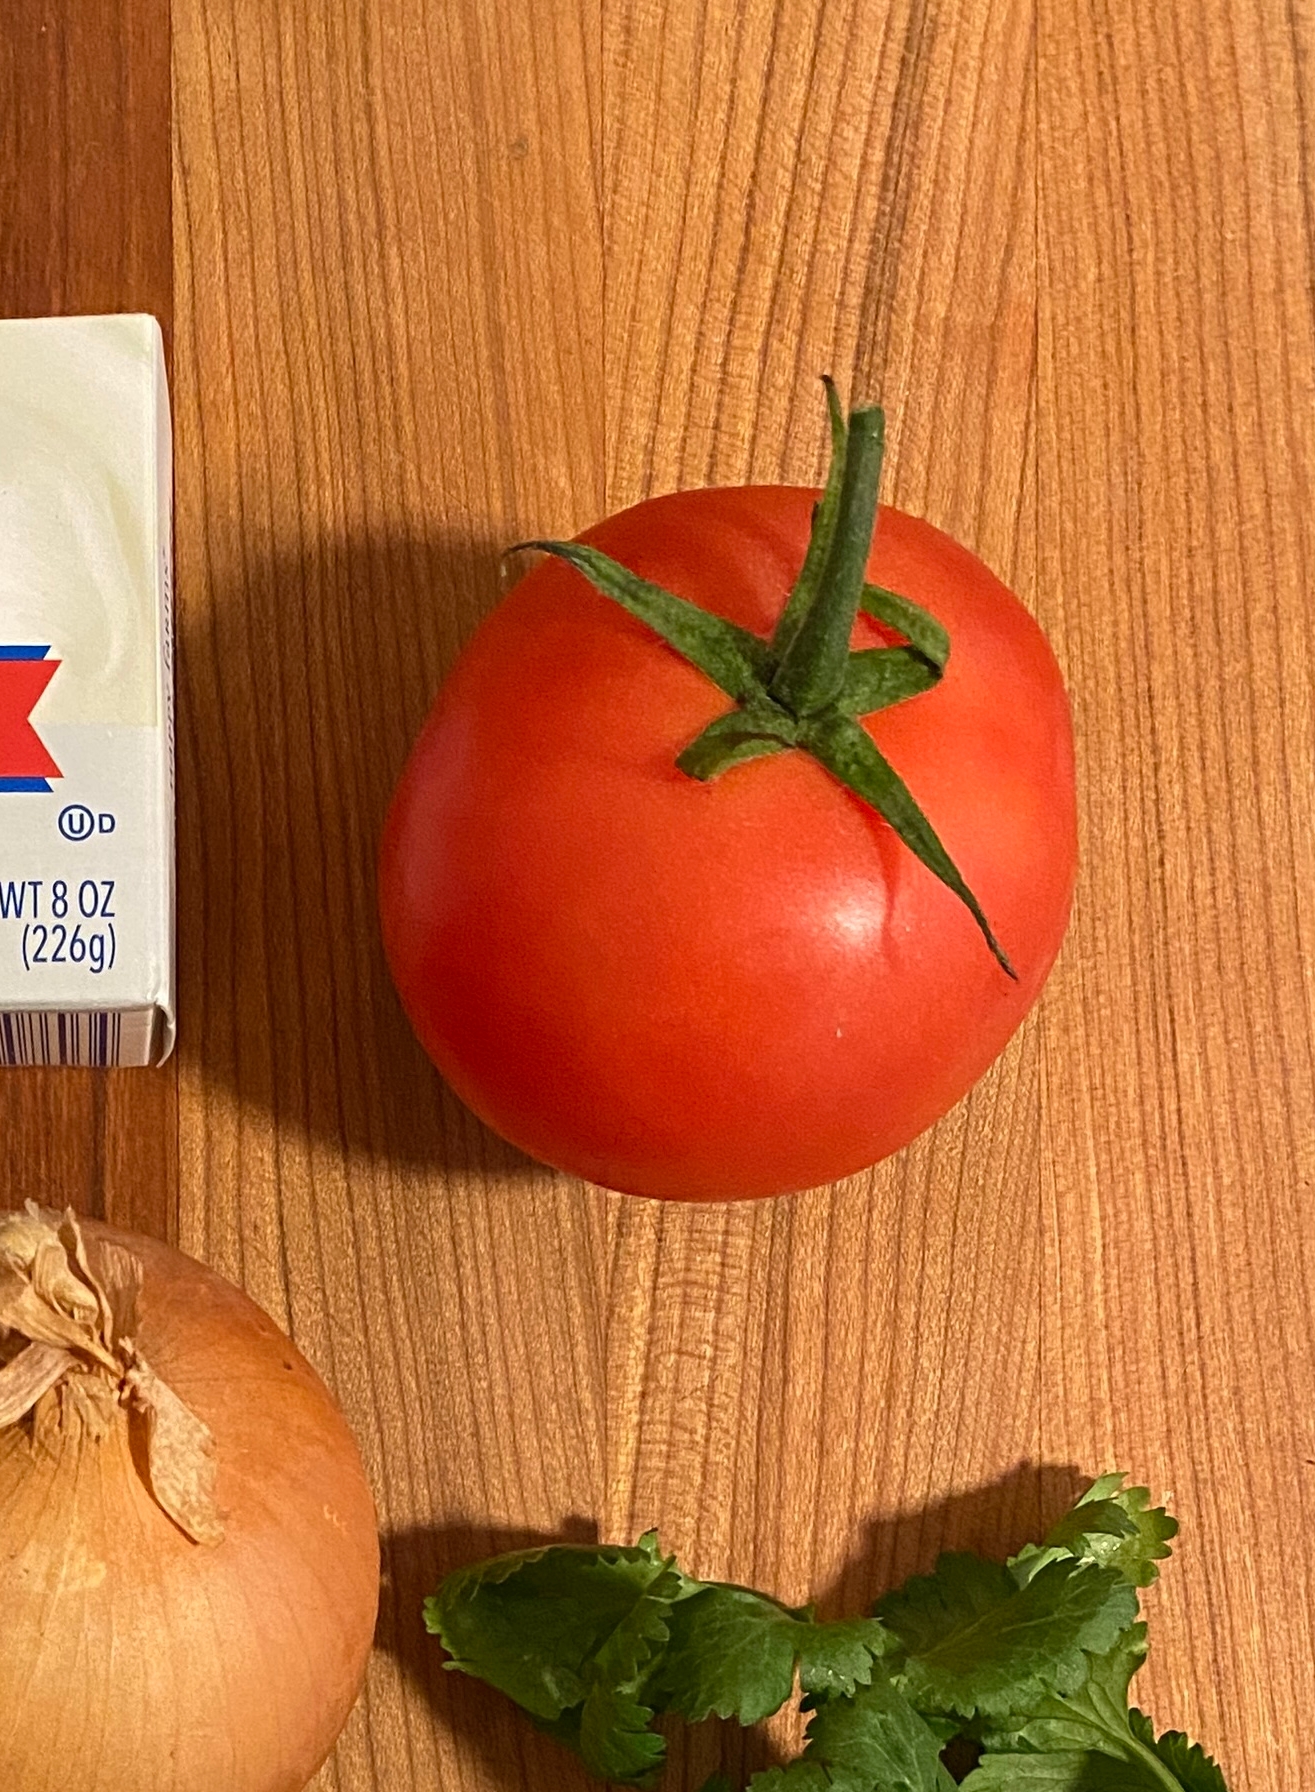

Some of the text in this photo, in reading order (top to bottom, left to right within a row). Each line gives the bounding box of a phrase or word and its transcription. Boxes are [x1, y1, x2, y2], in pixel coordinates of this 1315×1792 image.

[51, 880, 69, 919] 8
[79, 879, 116, 918] OZ
[21, 922, 117, 973] (226g)
